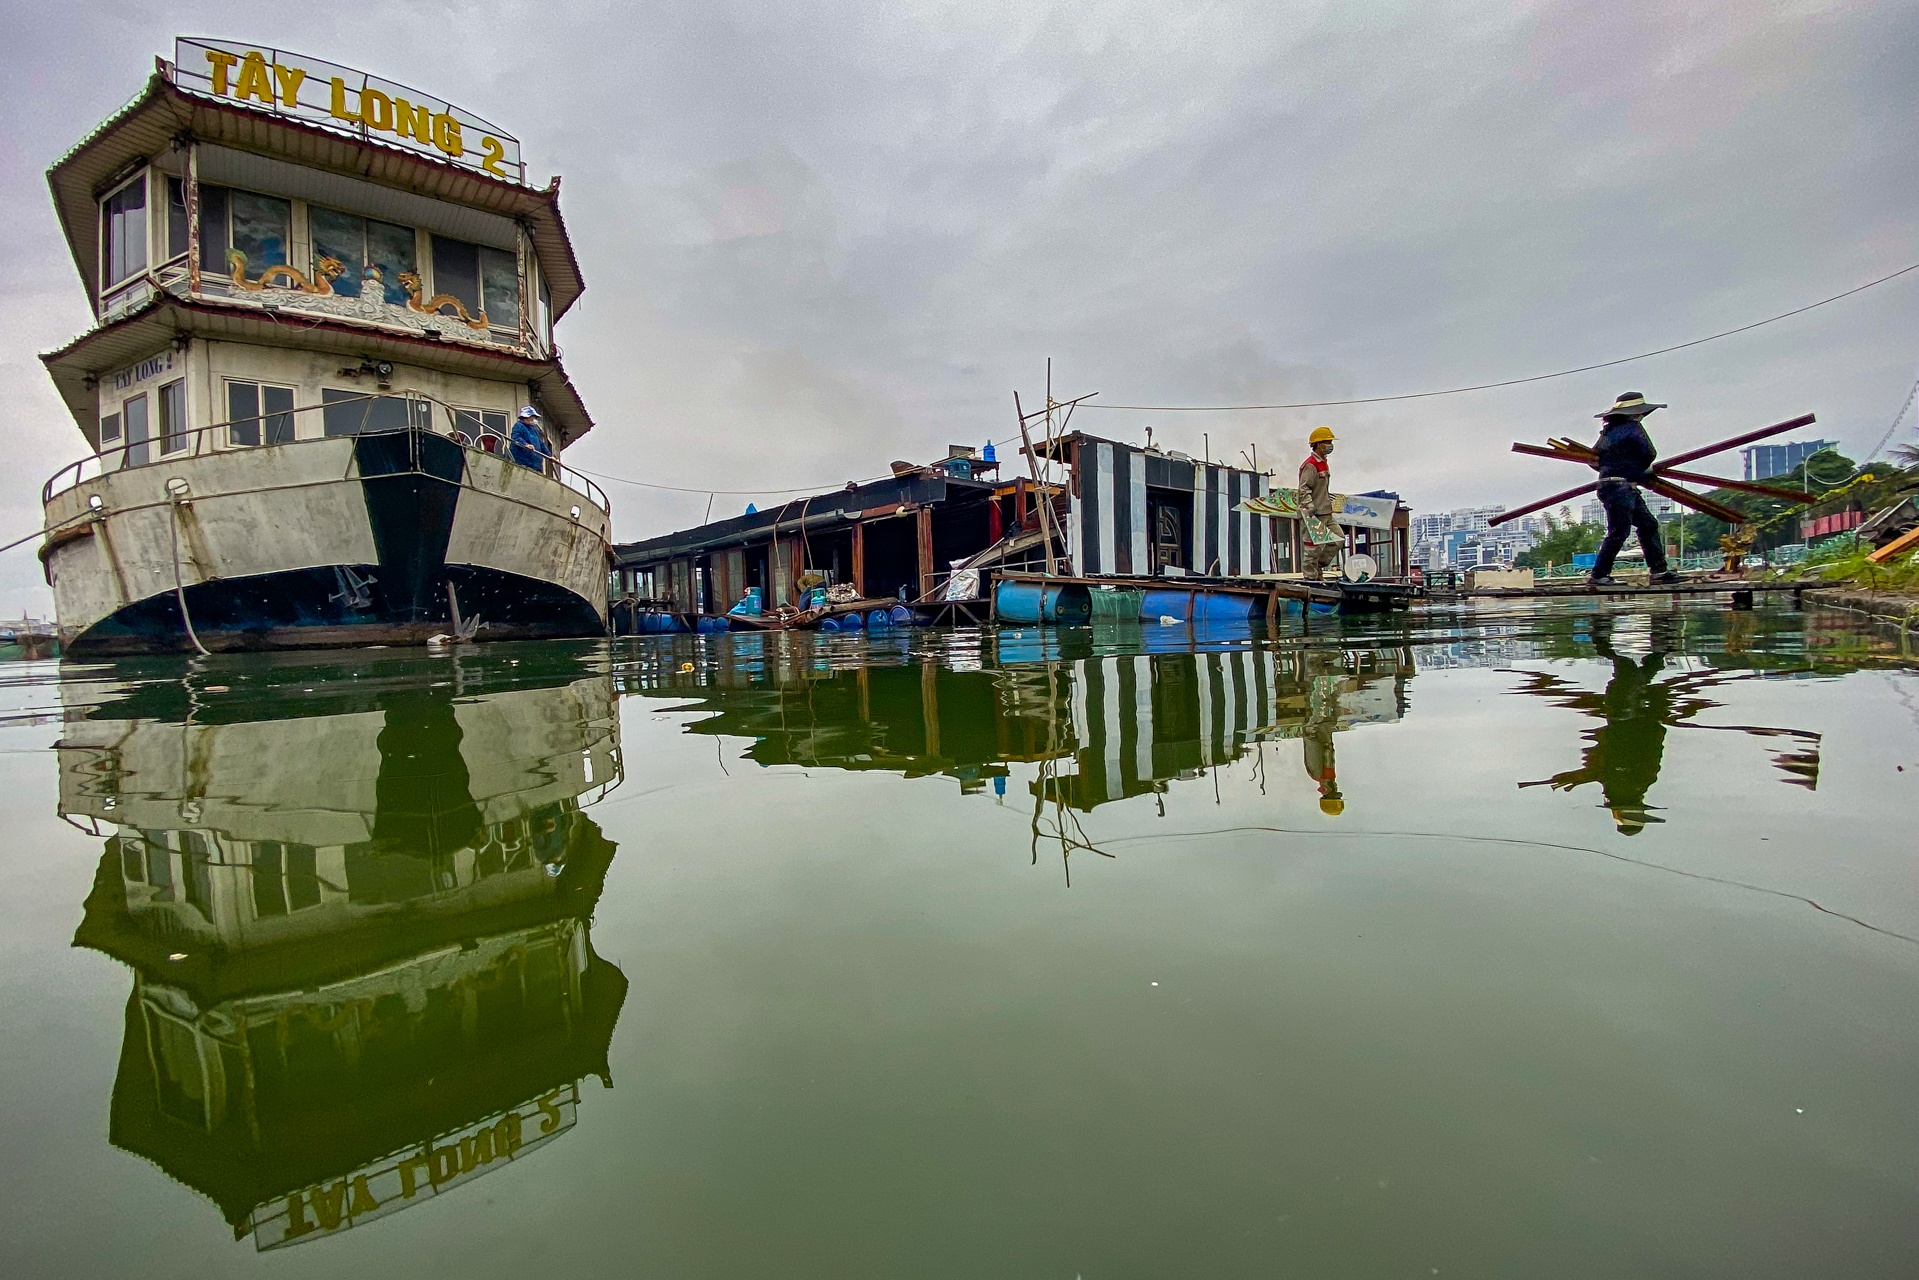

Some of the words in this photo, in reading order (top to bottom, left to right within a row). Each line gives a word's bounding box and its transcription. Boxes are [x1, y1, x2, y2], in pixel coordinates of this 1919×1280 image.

[205, 51, 307, 108] TÂY
[331, 77, 464, 157] LONG
[481, 136, 506, 178] 2
[135, 357, 163, 381] LONG
